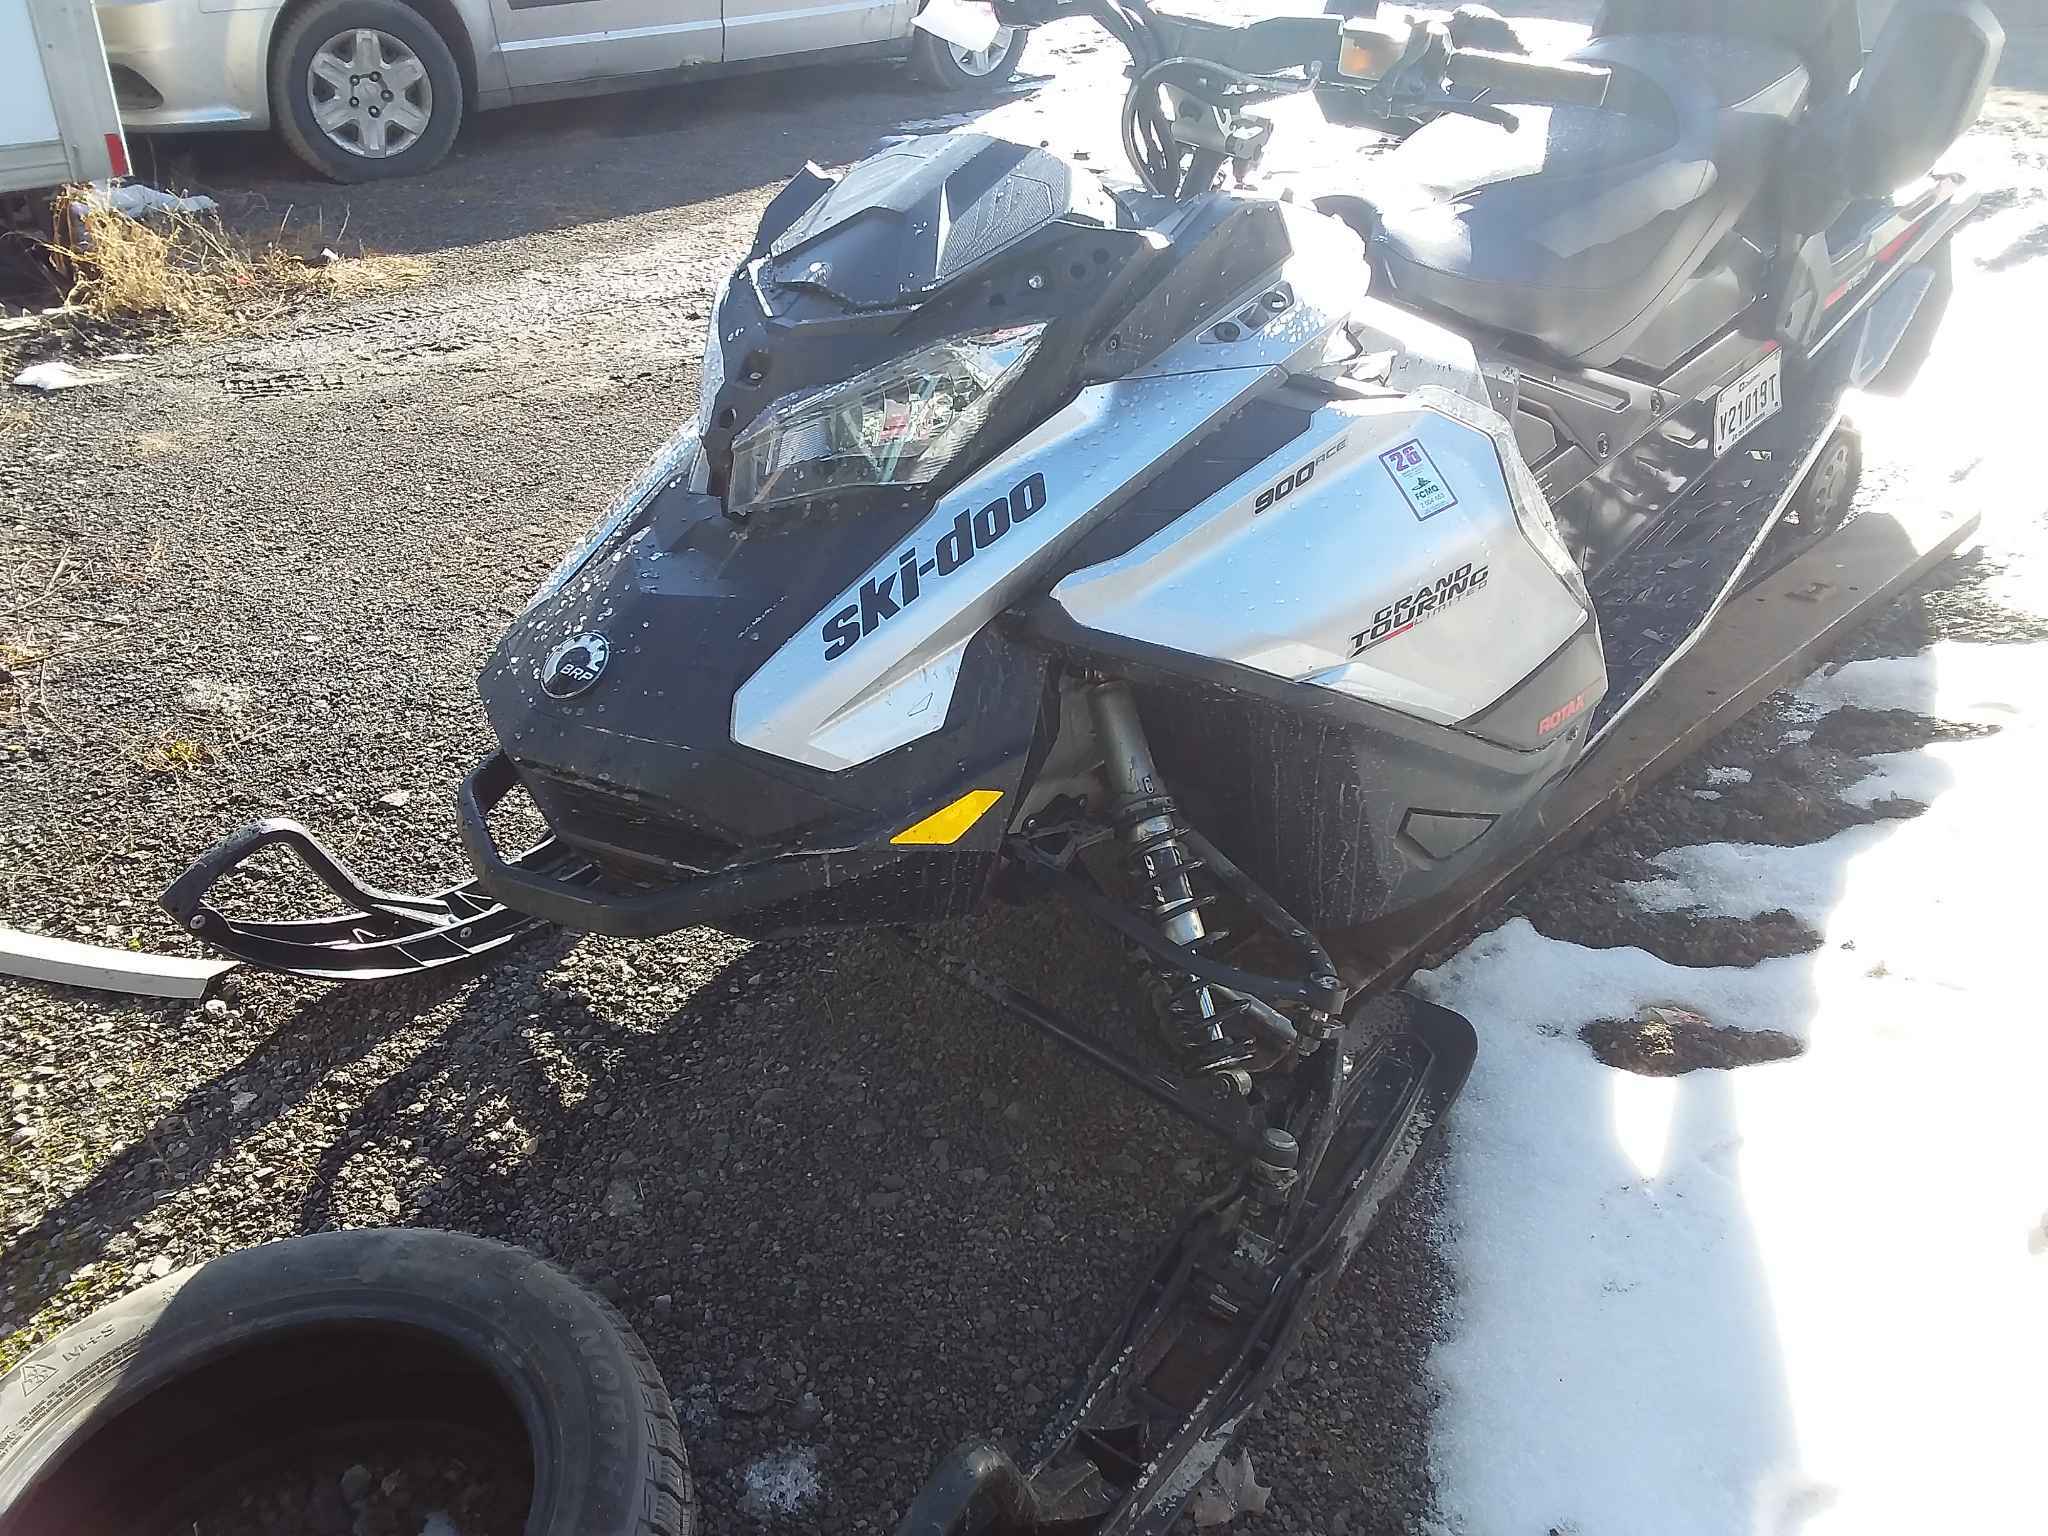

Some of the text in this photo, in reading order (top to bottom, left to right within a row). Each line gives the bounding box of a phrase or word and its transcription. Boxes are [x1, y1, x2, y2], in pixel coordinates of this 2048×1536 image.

[1388, 445, 1422, 472] 26
[1254, 461, 1315, 514] 900
[1414, 484, 1440, 500] FCMQ
[1350, 565, 1489, 648] TOURING
[1373, 562, 1472, 624] GRAND
[560, 663, 594, 681] BRP
